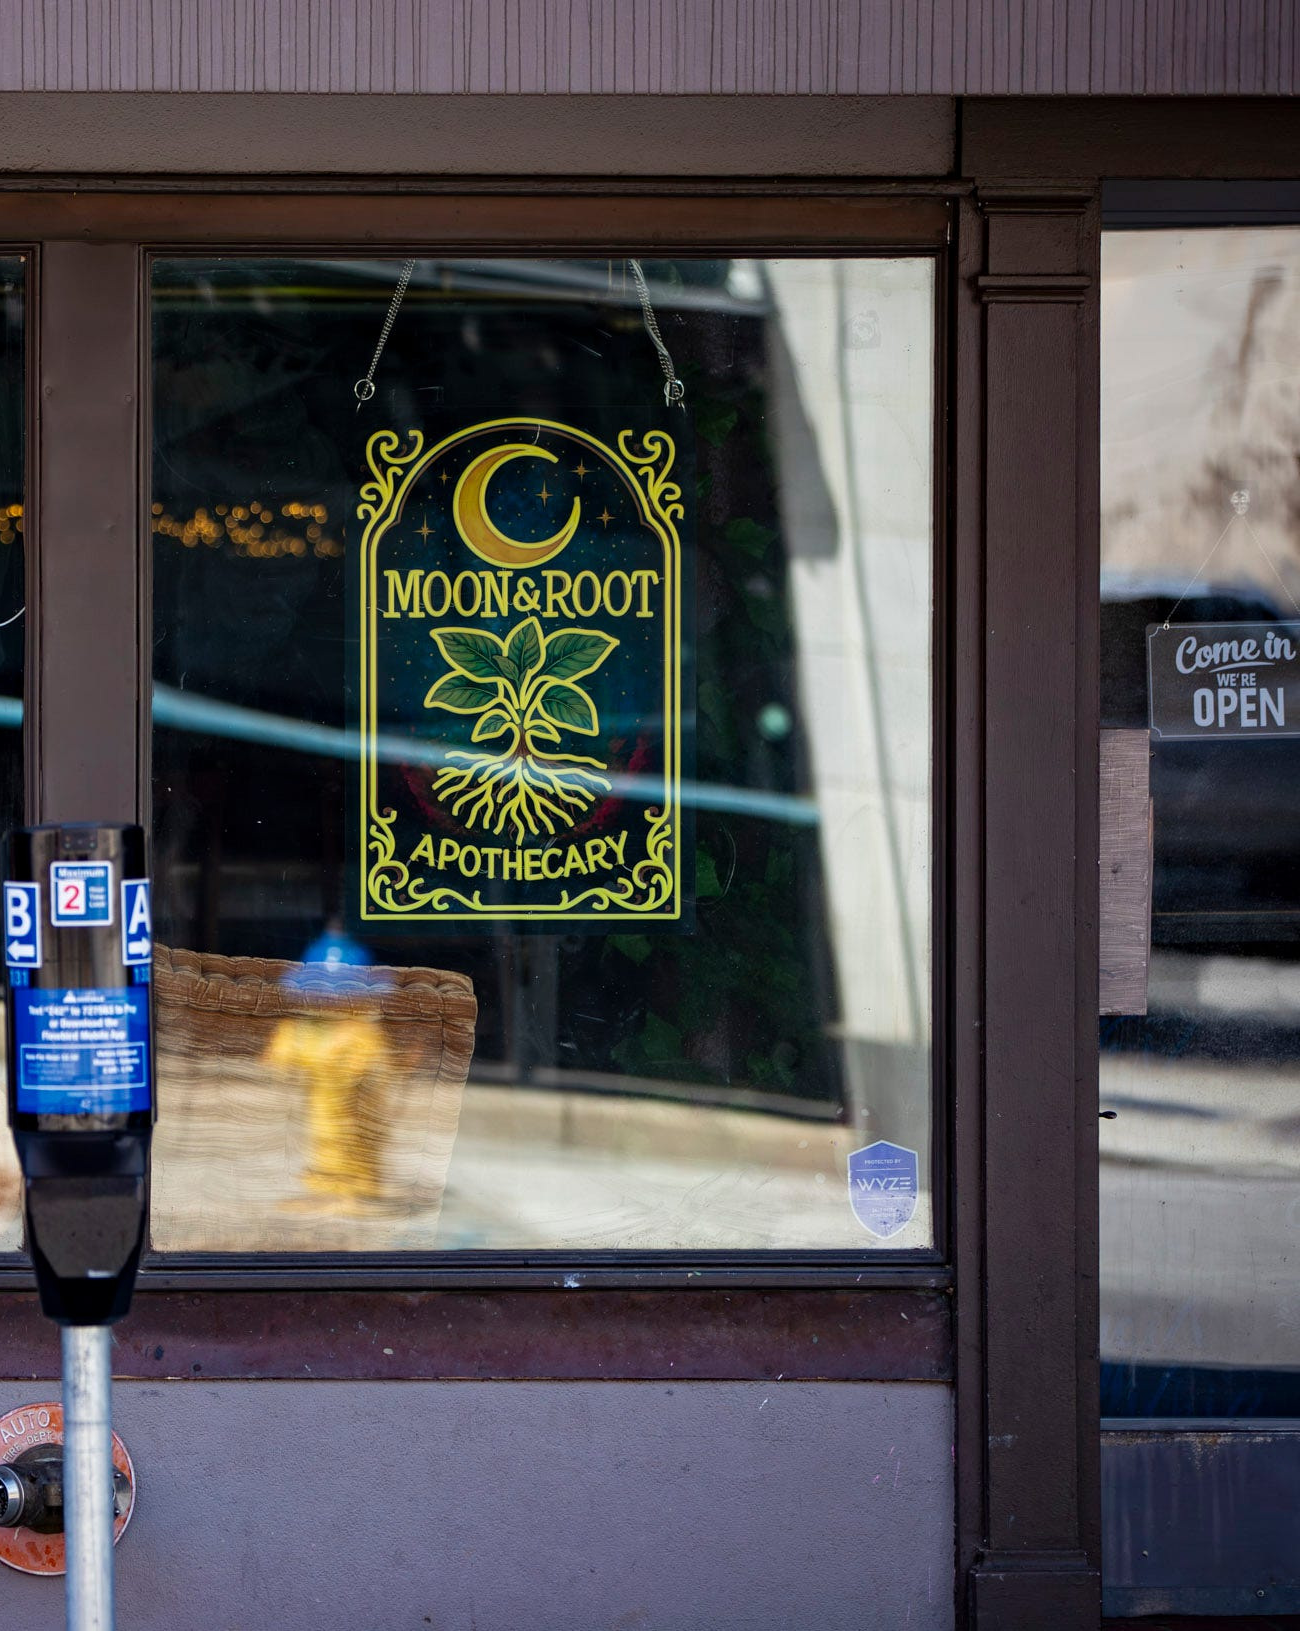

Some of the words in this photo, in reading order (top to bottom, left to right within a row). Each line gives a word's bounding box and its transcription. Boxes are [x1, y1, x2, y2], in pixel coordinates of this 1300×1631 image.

[1175, 635, 1261, 674] Come
[1263, 631, 1297, 661] in
[1216, 672, 1257, 687] WE'RE
[1193, 687, 1286, 728] OPEN
[409, 830, 629, 882] APOTHECARY
[6, 887, 32, 937] B
[63, 884, 81, 910] 2
[127, 884, 151, 935] A
[856, 1177, 911, 1192] WYZE
[0, 1408, 51, 1445] AUTO
[2, 1442, 22, 1463] FIRE
